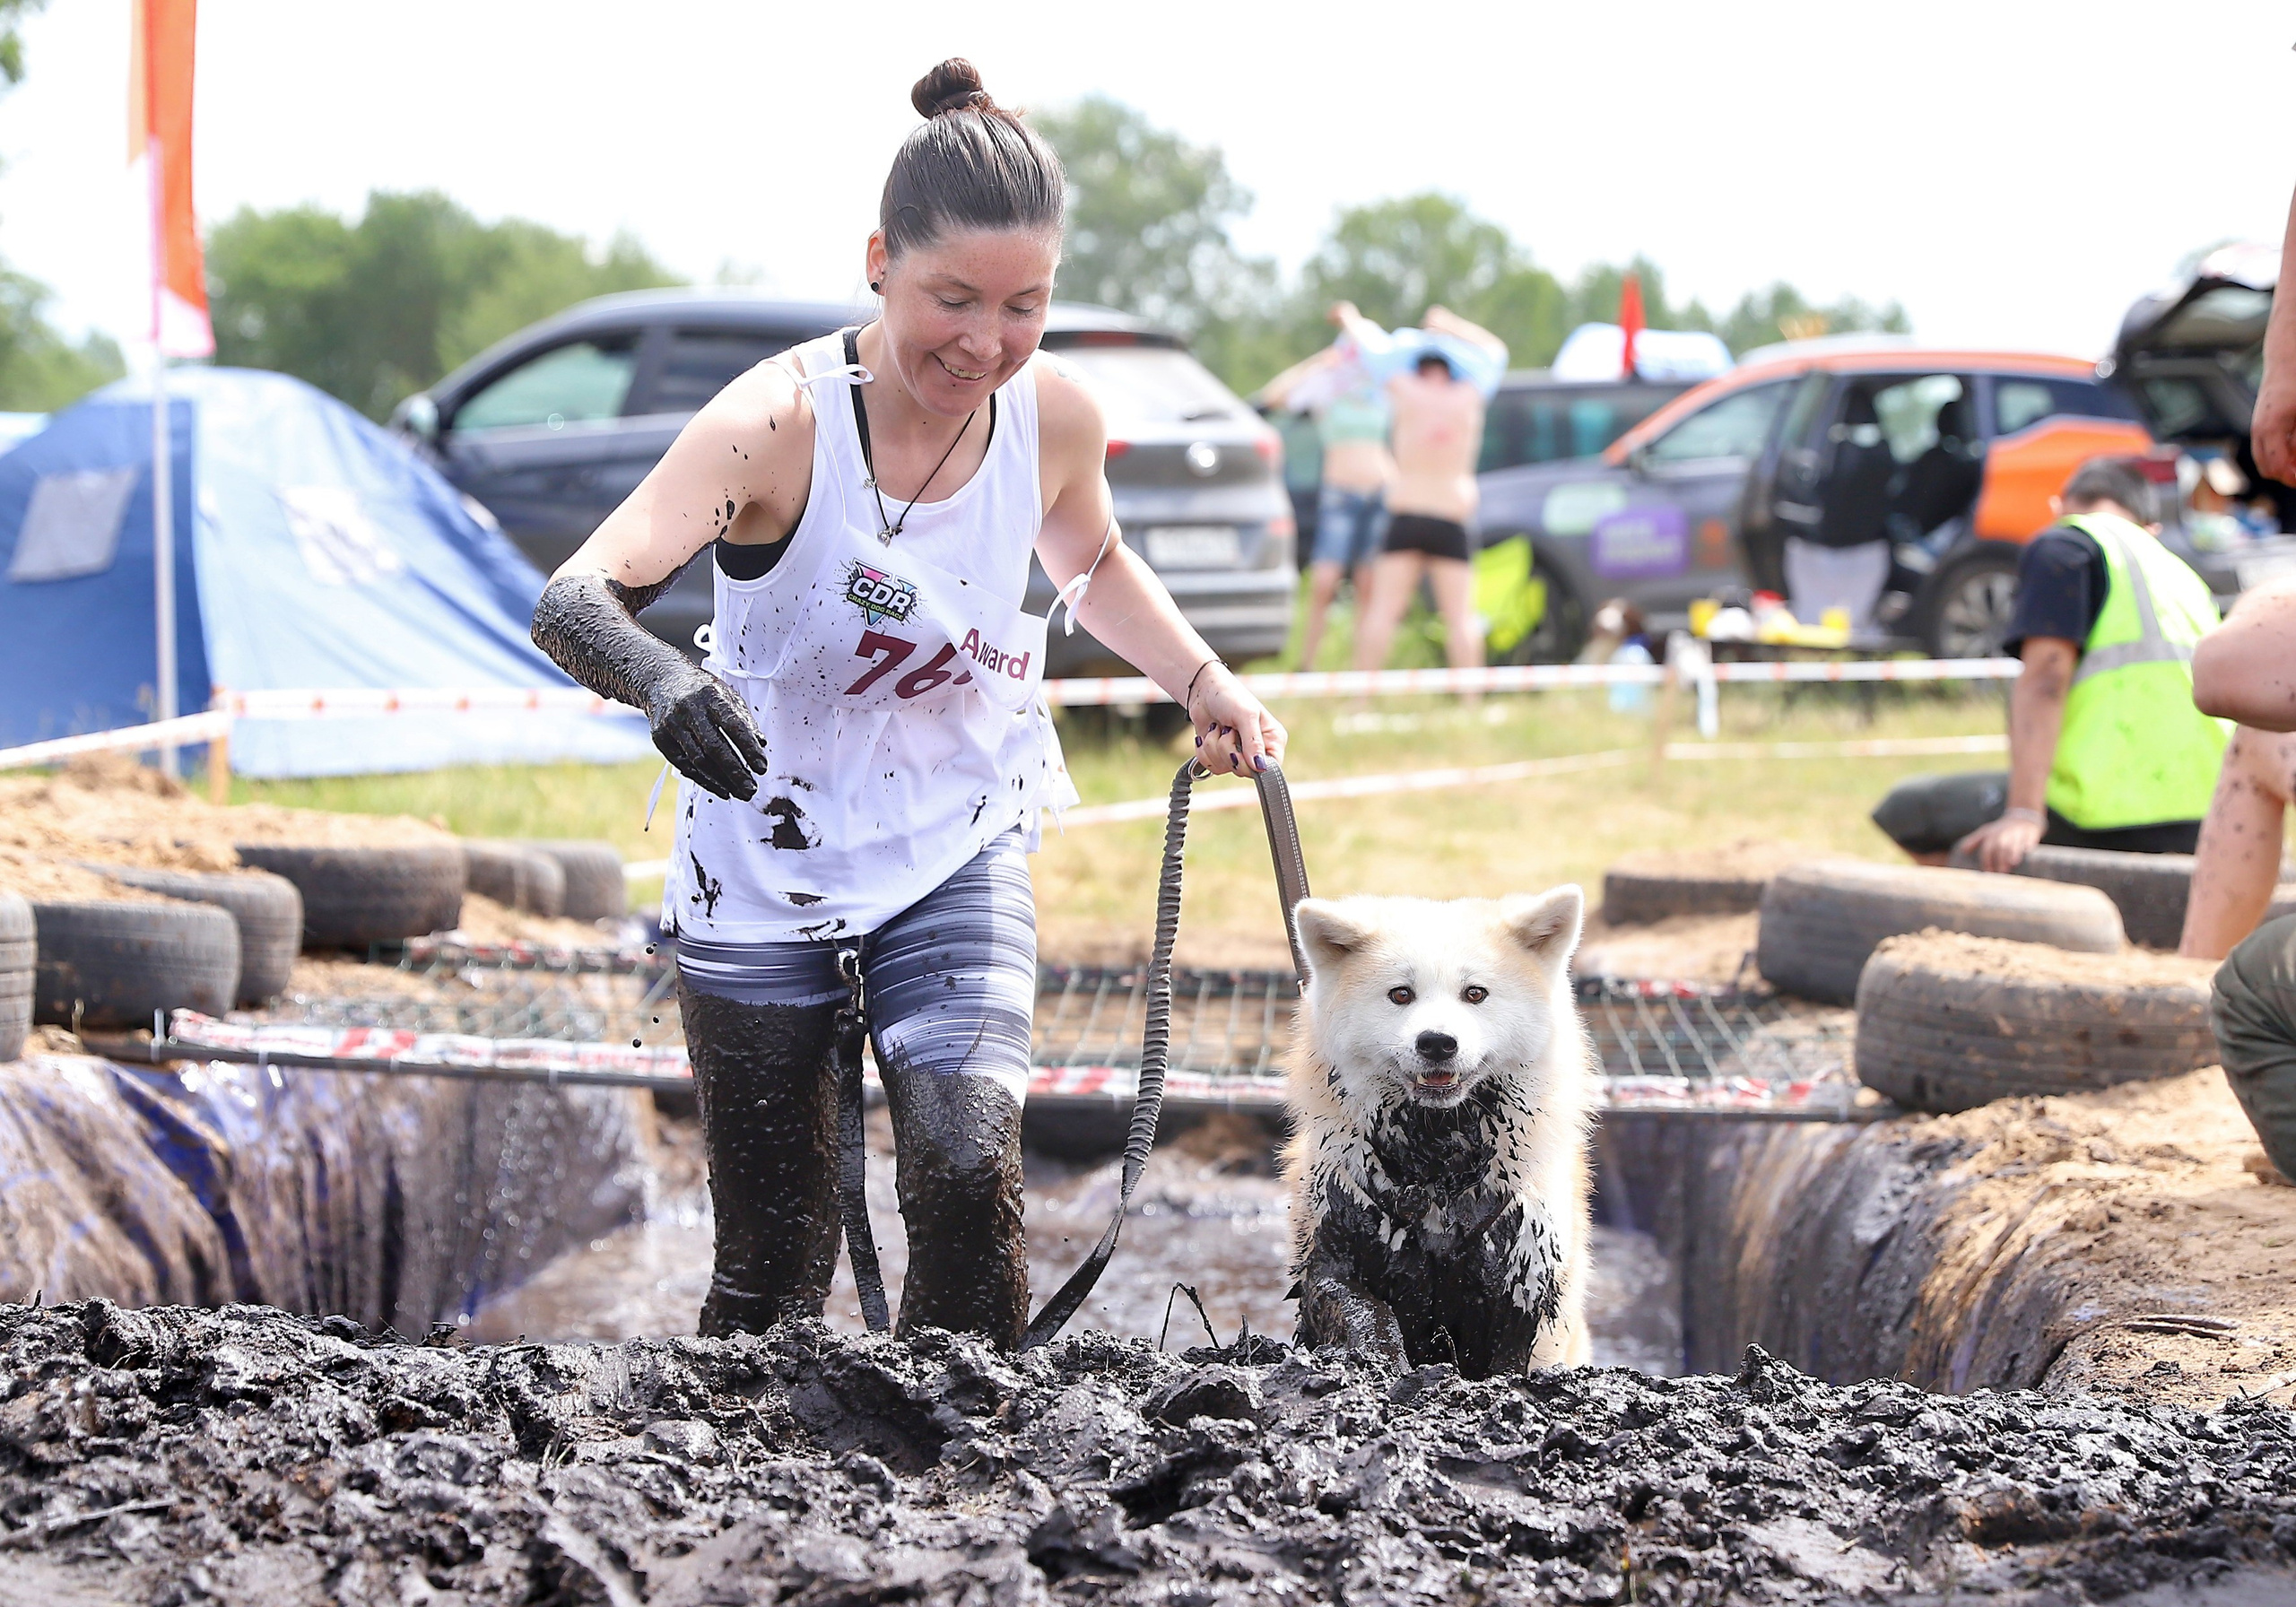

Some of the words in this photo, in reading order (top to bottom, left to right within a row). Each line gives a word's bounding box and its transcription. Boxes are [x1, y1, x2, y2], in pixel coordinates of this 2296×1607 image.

[848, 593, 871, 607] CRAZY
[870, 602, 886, 612] DOG
[885, 609, 904, 620] RACE
[852, 577, 912, 613] CDR
[843, 630, 974, 699] 76
[959, 627, 1031, 681] Award
